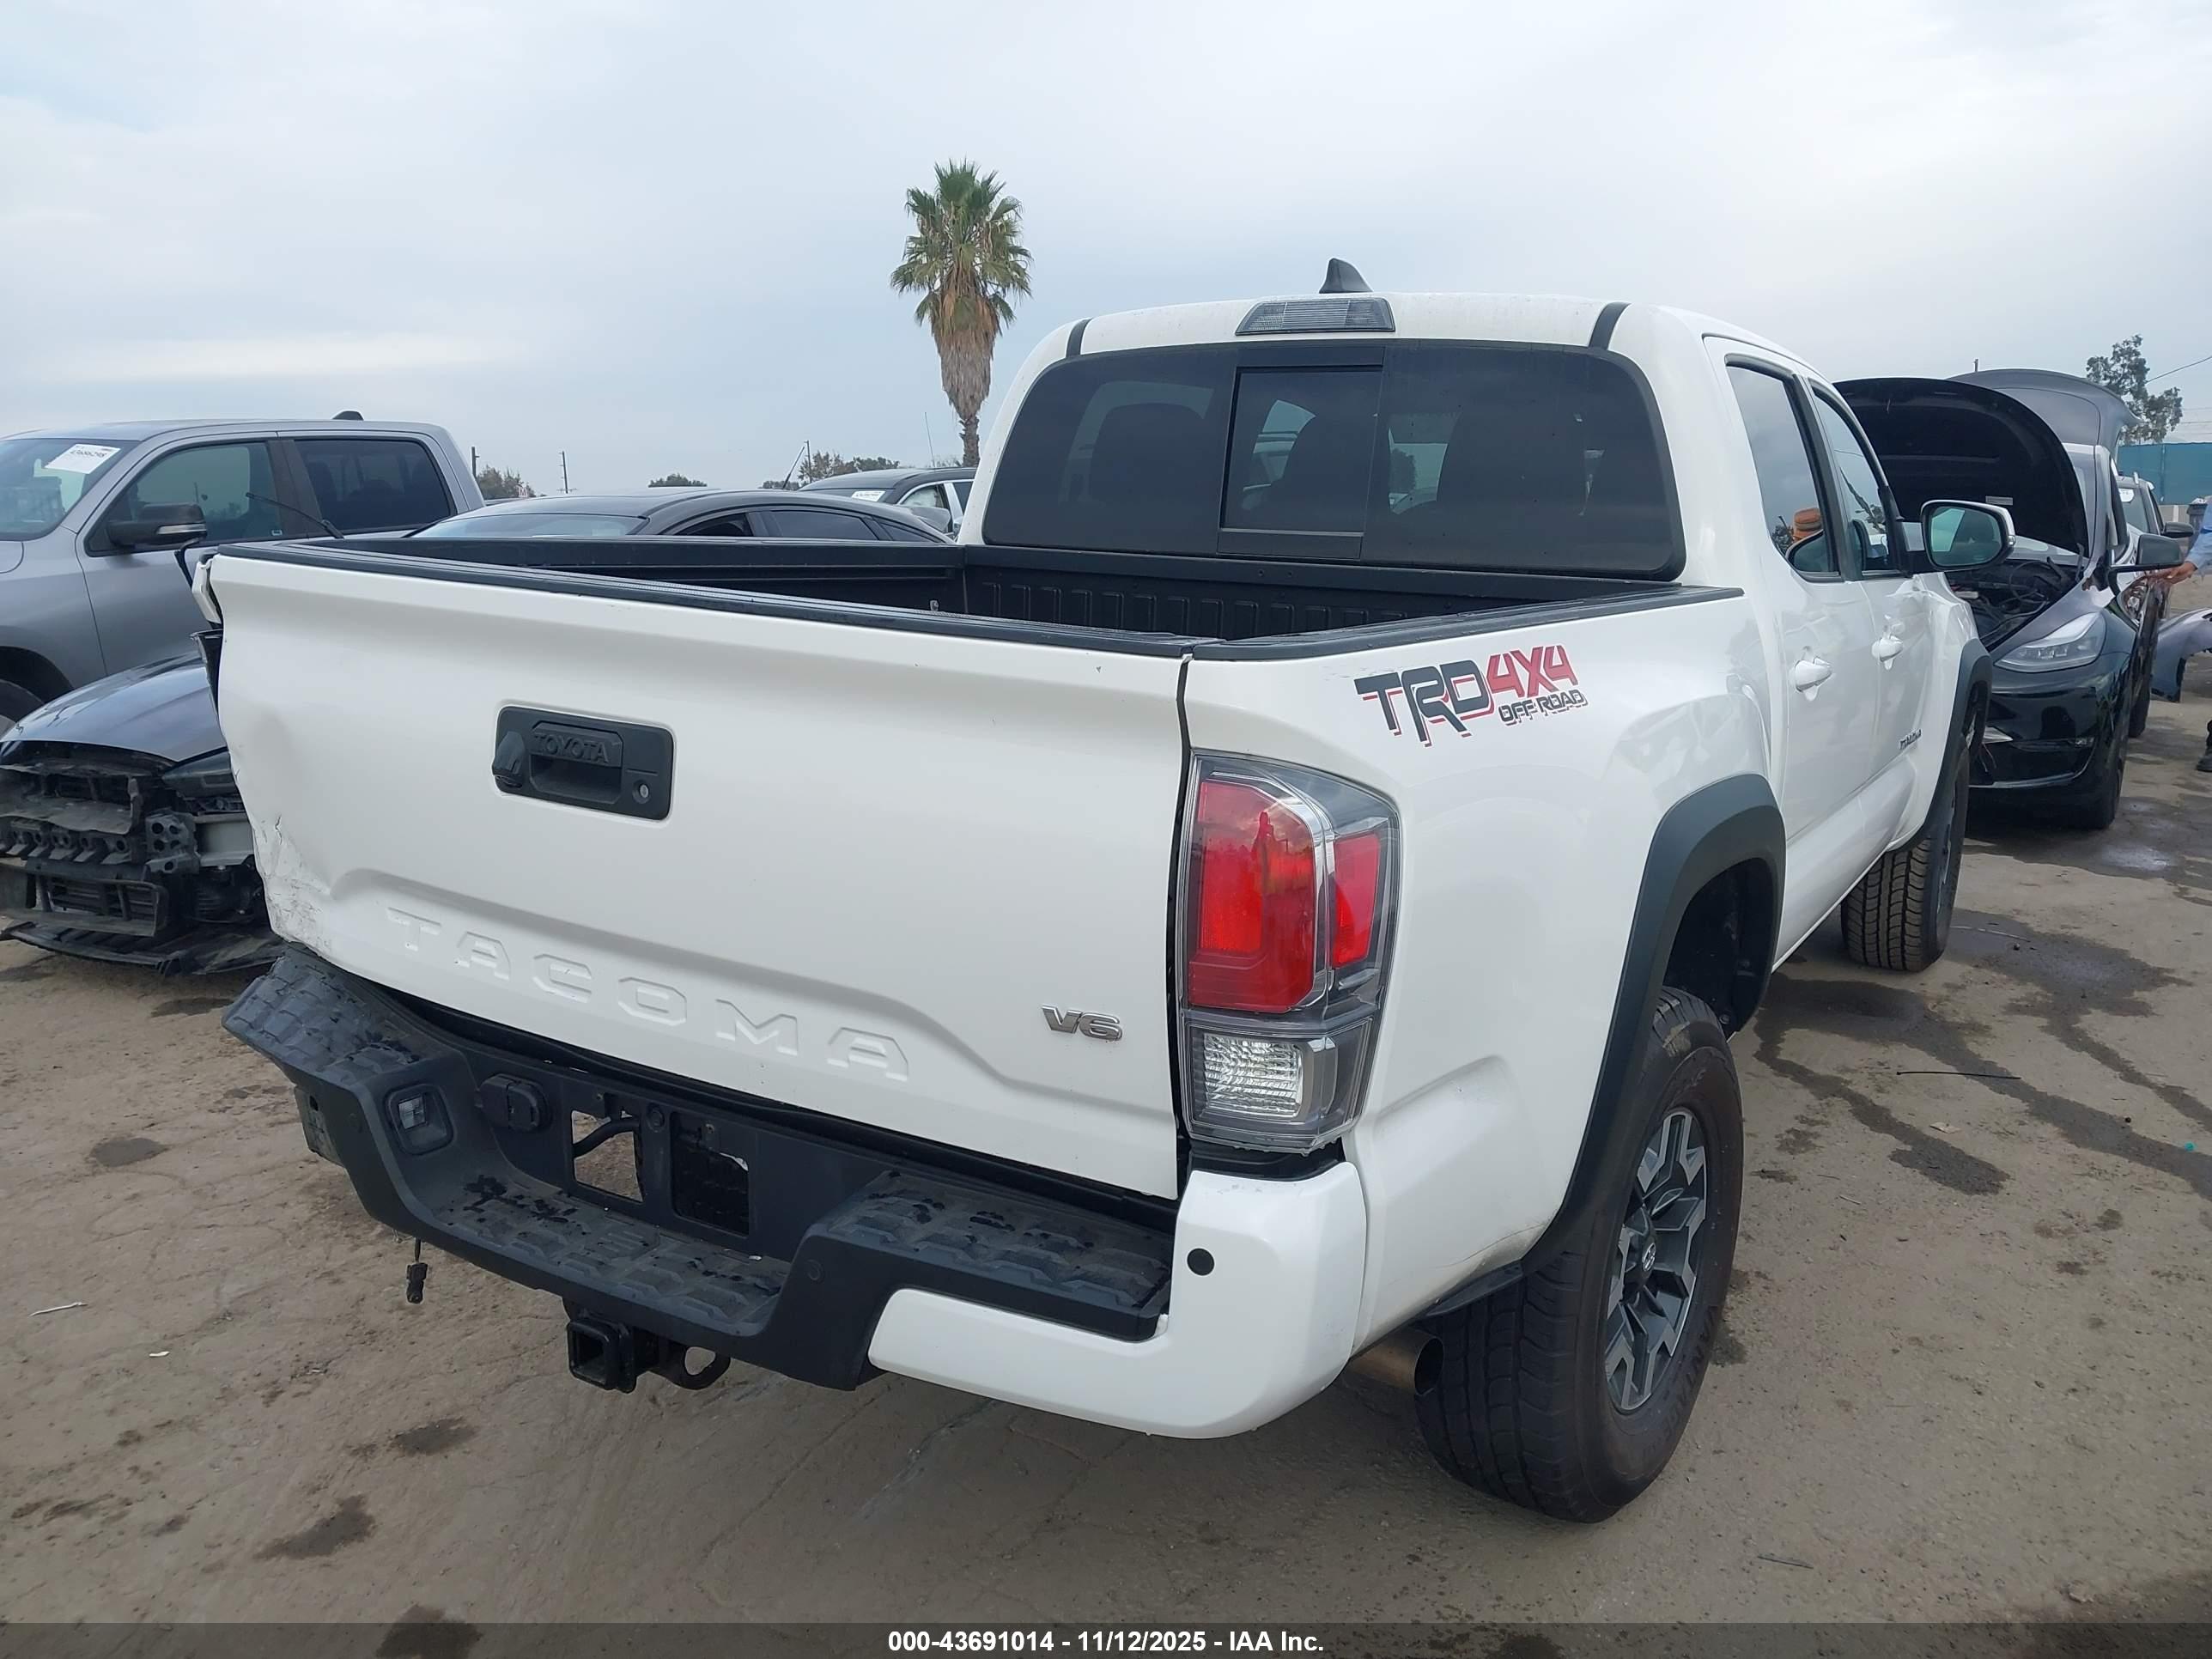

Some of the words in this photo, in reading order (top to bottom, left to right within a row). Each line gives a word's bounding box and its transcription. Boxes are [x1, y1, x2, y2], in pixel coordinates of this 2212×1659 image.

[1353, 659, 1495, 748] TRD
[1486, 644, 1579, 699] 4X4
[1498, 697, 1537, 726] OFF
[1538, 689, 1589, 717] ROAD
[533, 732, 611, 763] TOYOTA
[386, 907, 910, 1082] TACOMA
[1041, 1004, 1123, 1042] V6
